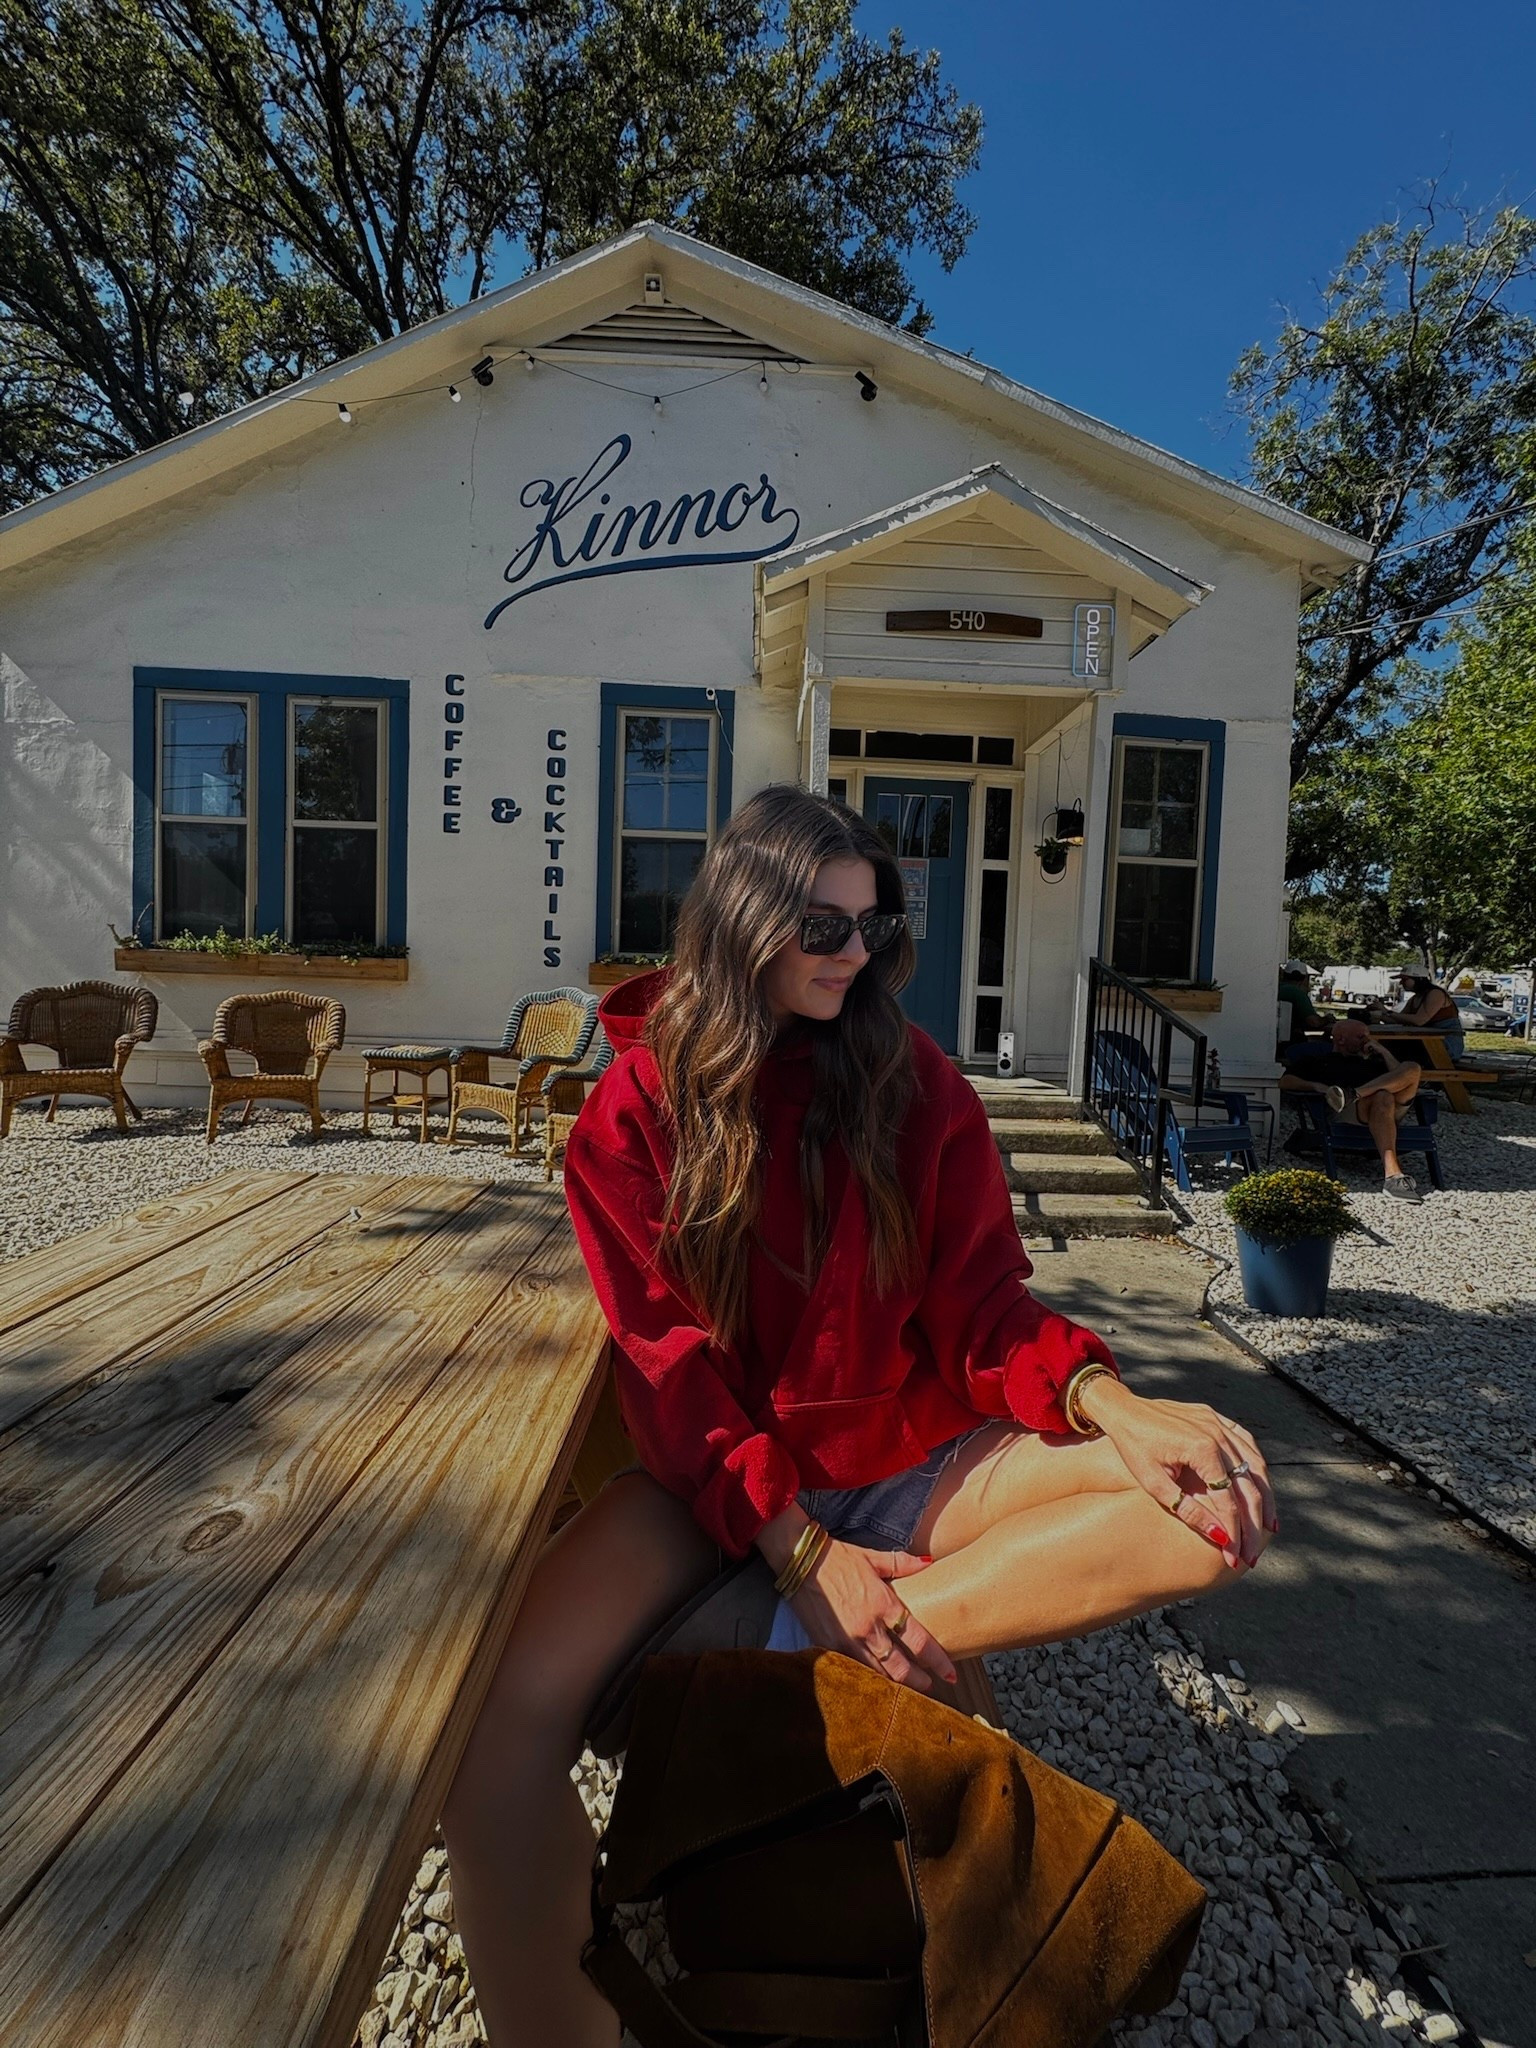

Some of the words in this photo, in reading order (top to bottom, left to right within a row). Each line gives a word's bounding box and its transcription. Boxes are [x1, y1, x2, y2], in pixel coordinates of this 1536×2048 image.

[504, 433, 800, 583] Kinnor
[950, 611, 985, 630] 540
[1085, 609, 1100, 674] OPEN
[443, 674, 465, 834] COFFEE
[491, 797, 522, 824] &
[543, 729, 567, 968] COCKTAILS
